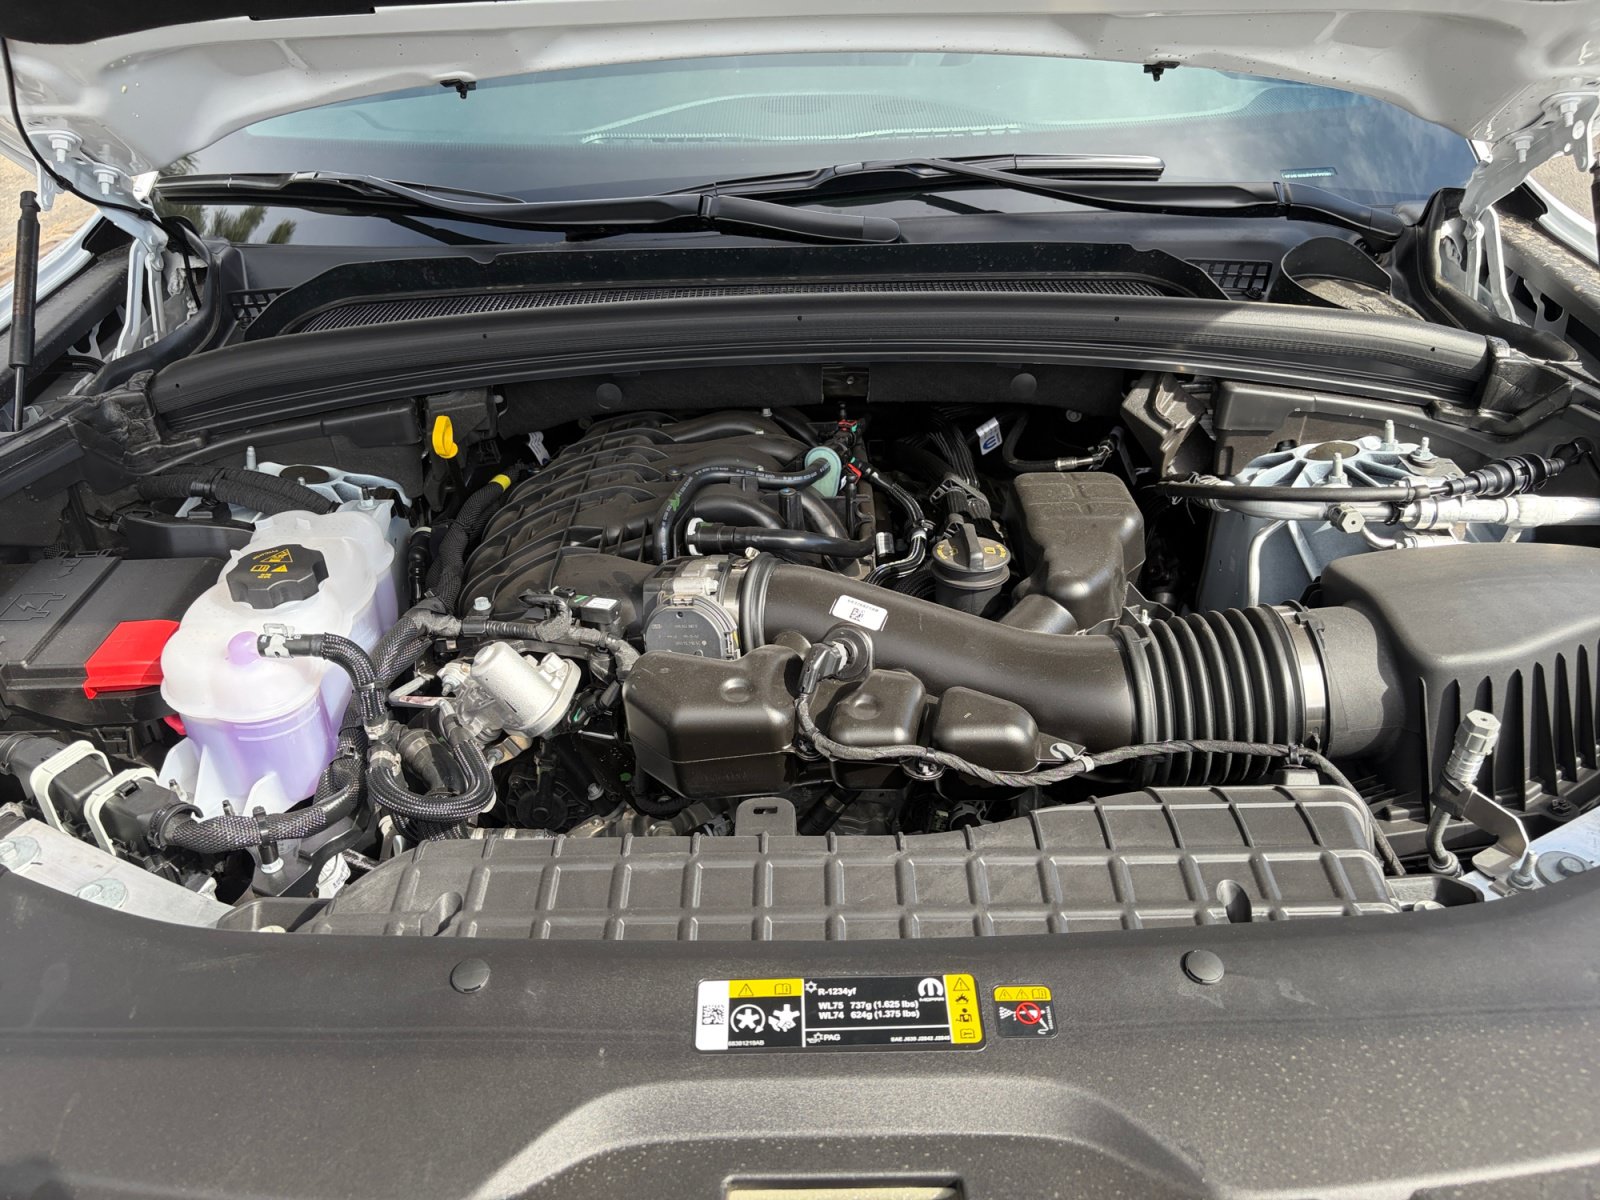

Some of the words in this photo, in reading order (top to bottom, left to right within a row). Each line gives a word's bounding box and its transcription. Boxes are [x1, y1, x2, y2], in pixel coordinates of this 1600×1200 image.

[818, 987, 856, 996] R-1234yf
[818, 1002, 844, 1010] WL75
[850, 1001, 872, 1010] 737g
[873, 1000, 900, 1010] (1.625
[901, 1000, 919, 1009] lbs)
[818, 1011, 844, 1020] WL74
[850, 1010, 873, 1020] 624g
[874, 1010, 901, 1019] (1.375
[902, 1010, 920, 1019] lbs)
